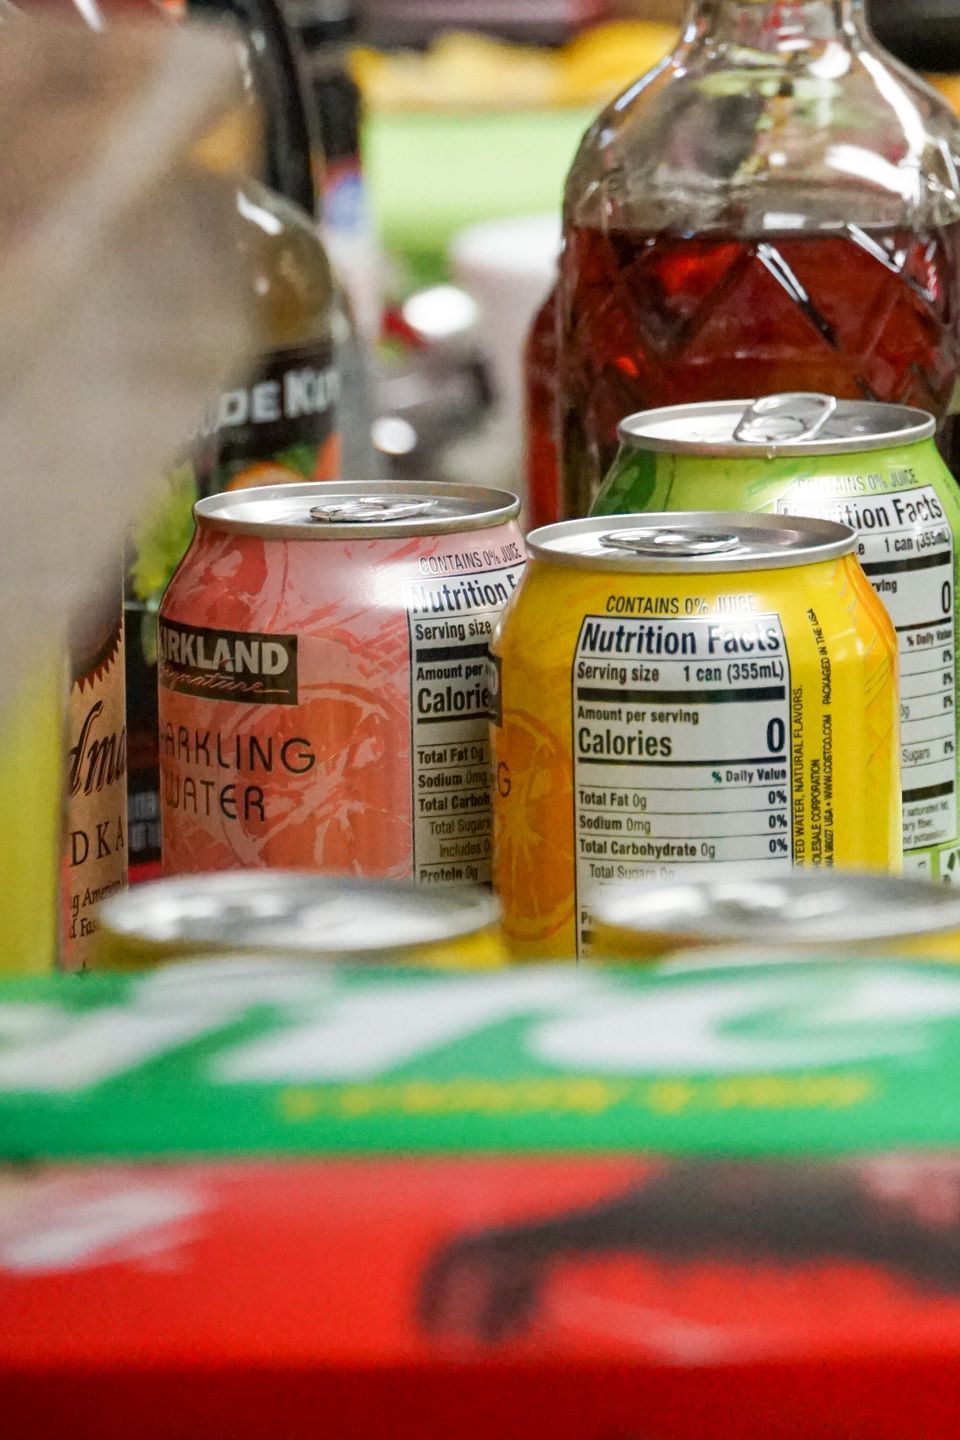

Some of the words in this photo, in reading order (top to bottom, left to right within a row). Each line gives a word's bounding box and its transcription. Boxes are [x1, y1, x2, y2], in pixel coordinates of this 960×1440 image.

[891, 494, 943, 526] Facts
[884, 538, 890, 552] 1
[894, 538, 913, 552] can
[916, 528, 950, 553] (355mL)
[419, 551, 482, 575] CONTAINS
[483, 551, 500, 566] 0%
[501, 542, 522, 561] JUICE
[412, 578, 508, 614] Nutrition
[606, 595, 679, 615] CONTAINS
[684, 598, 709, 615] 0%
[941, 580, 951, 615] 0
[806, 608, 819, 626] USA
[415, 621, 465, 641] Serving
[469, 618, 492, 636] size
[581, 622, 697, 655] Nutrition
[707, 622, 780, 654] Facts
[417, 664, 463, 681] Amount
[465, 663, 483, 680] per
[577, 661, 628, 684] Serving
[631, 664, 659, 681] size
[683, 665, 690, 682] 1
[696, 665, 722, 681] can
[727, 660, 784, 684] (355mL)
[821, 657, 832, 705] PACKAGED
[578, 705, 622, 722] Amount
[626, 709, 647, 725] per
[651, 710, 699, 725] serving
[793, 684, 804, 739] FLAVORS.
[161, 721, 316, 774] ARKLING
[578, 727, 673, 758] Calories
[766, 717, 785, 753] 0
[418, 747, 447, 764] Total
[451, 745, 469, 763] Fat
[471, 746, 484, 761] 0g
[902, 748, 930, 764] Sugars
[726, 770, 754, 783] Daily
[758, 768, 787, 781] Value
[793, 741, 805, 793] NATURAL
[418, 771, 463, 788] Sodium
[579, 791, 606, 806] Total
[610, 793, 628, 807] Fat
[632, 793, 647, 808] 0g
[768, 790, 787, 805] 0%
[811, 759, 821, 822] CORPORATION
[419, 796, 448, 812] Total
[429, 819, 455, 835] Total
[579, 815, 622, 831] Sodium
[626, 818, 651, 834] 0mg
[768, 814, 787, 829] 0%
[440, 840, 481, 858] Includes
[580, 839, 607, 854] Total
[611, 841, 697, 859] Carbohydrate
[701, 843, 716, 859] 0g
[769, 839, 788, 854] 0%
[811, 822, 822, 867] OLESALE
[420, 867, 463, 882] Protein
[590, 864, 615, 879] Total
